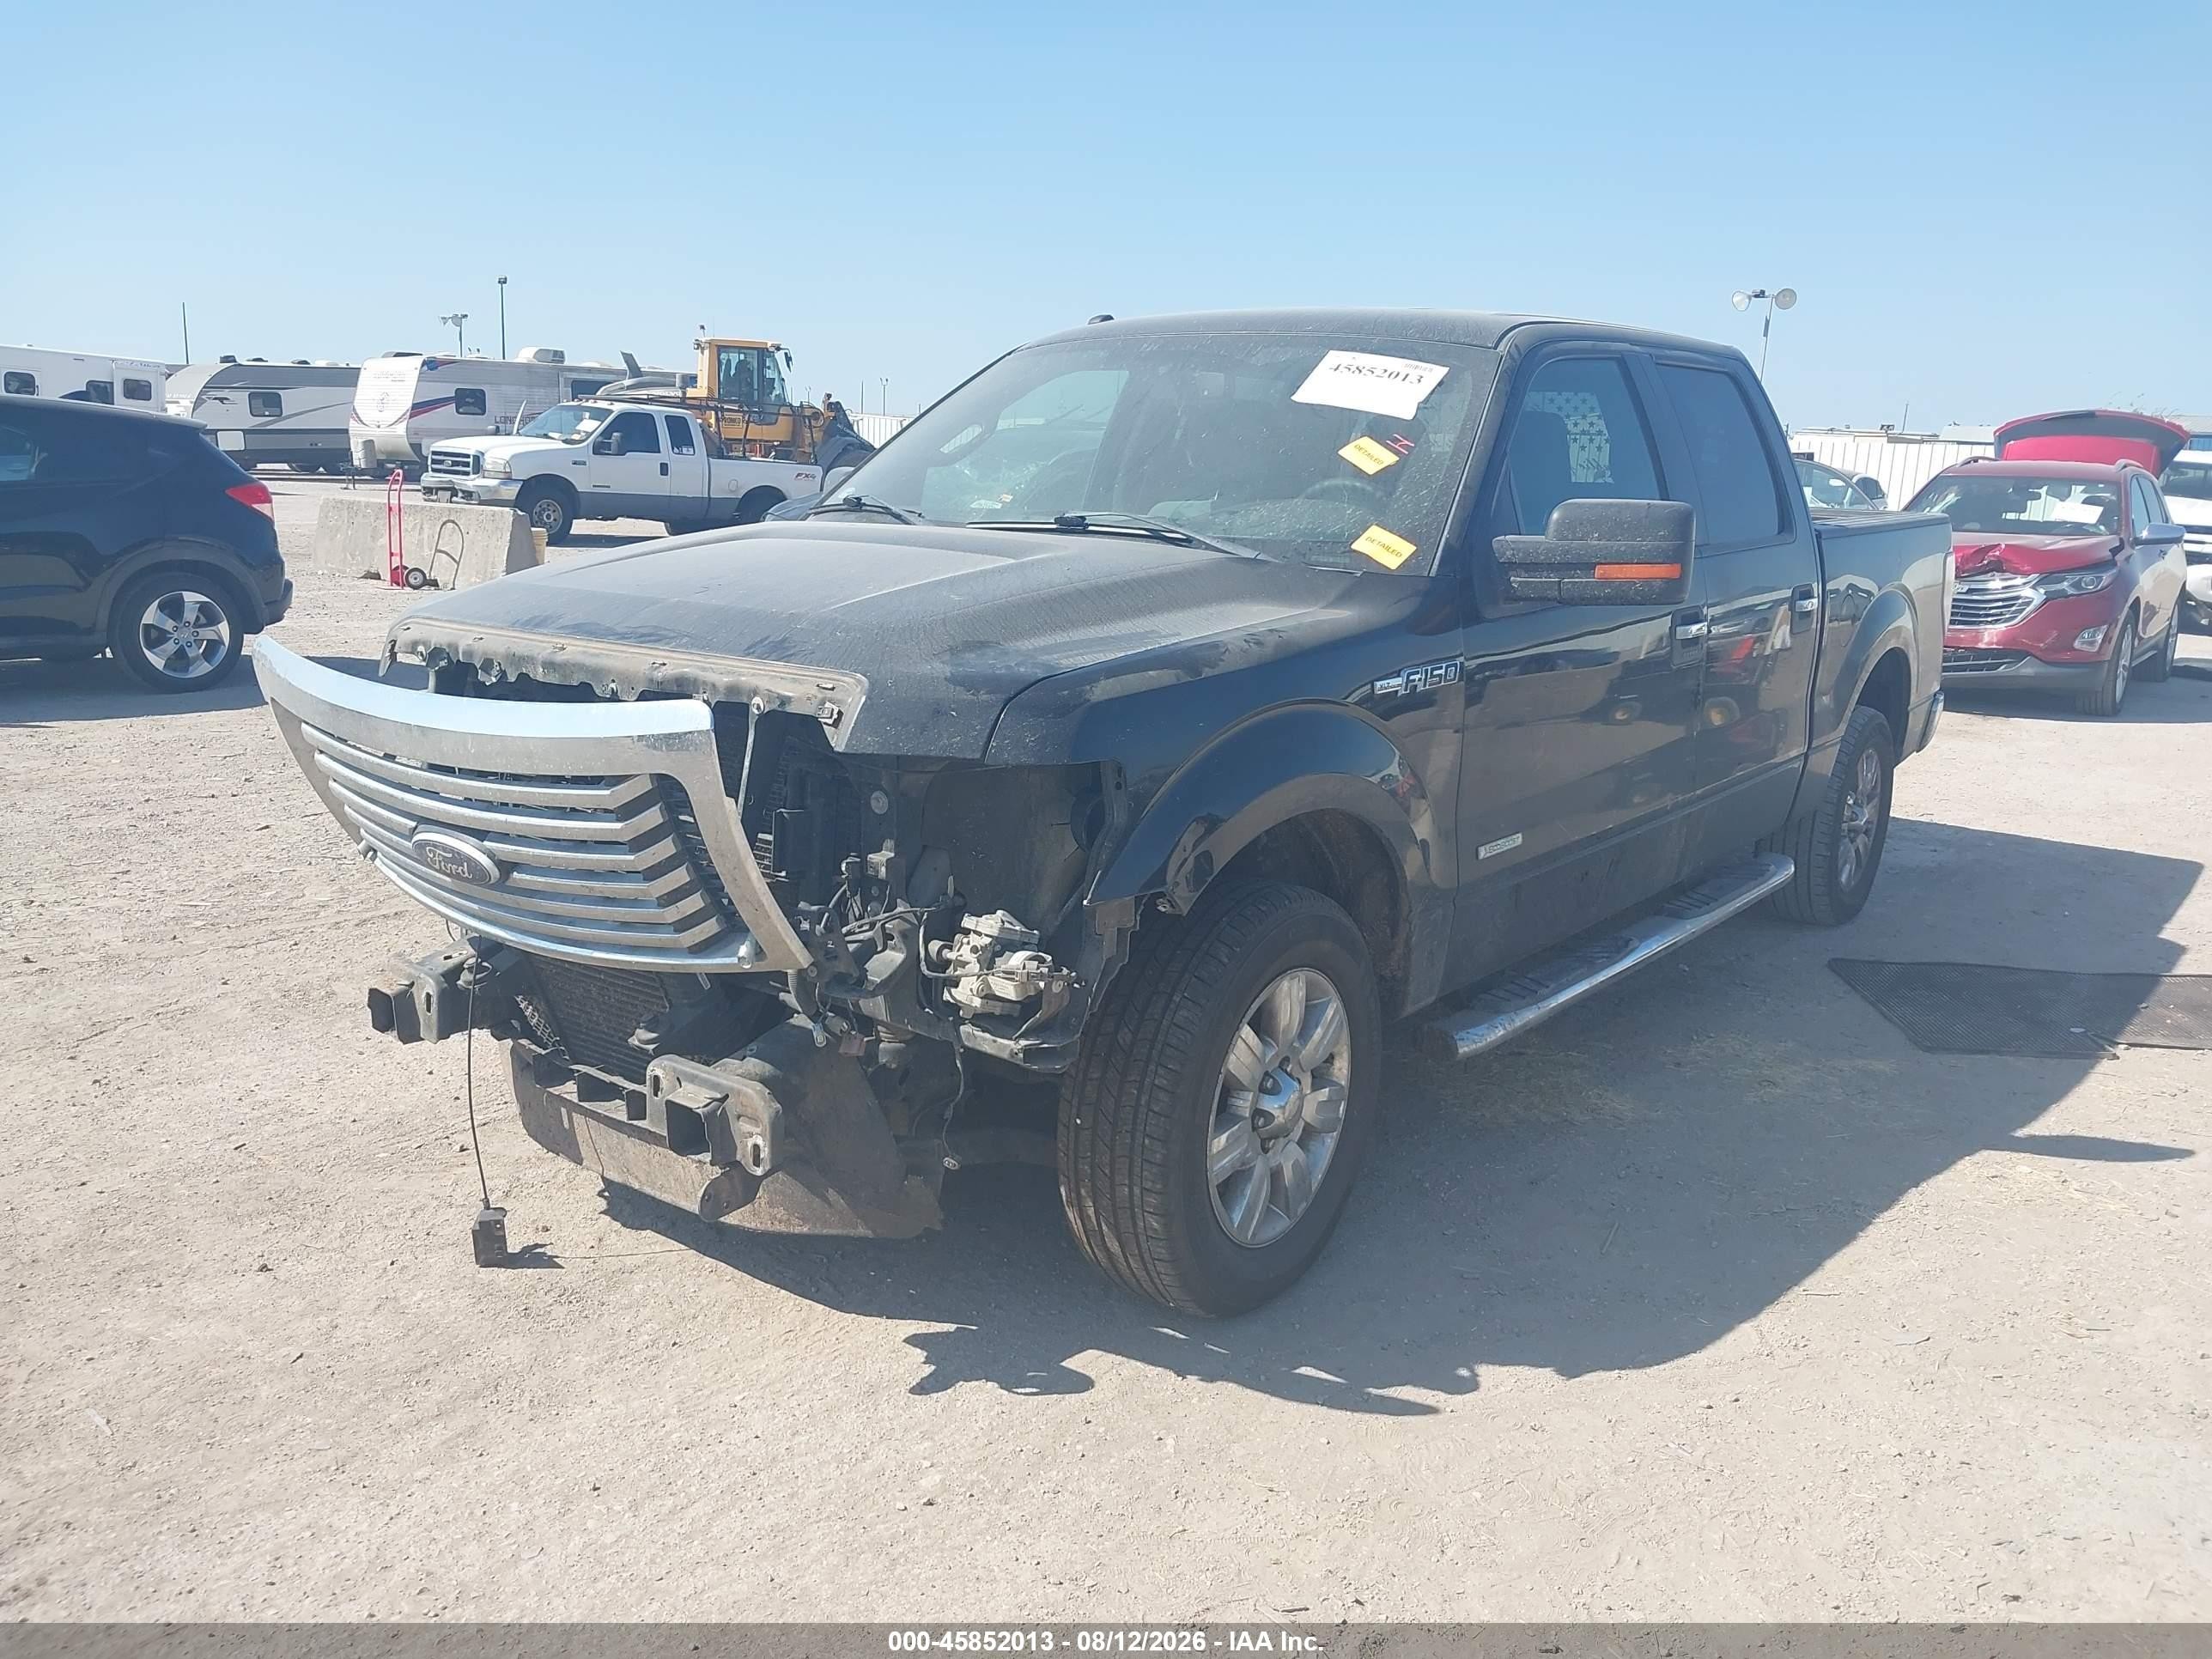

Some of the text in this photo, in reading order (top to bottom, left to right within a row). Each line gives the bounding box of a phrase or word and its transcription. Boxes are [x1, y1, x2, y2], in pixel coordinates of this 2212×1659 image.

[1328, 362, 1425, 385] 45852013
[1353, 443, 1384, 465] DETAILED
[1364, 535, 1403, 558] DETAILED
[1398, 660, 1460, 696] F150
[426, 846, 473, 879] Ford
